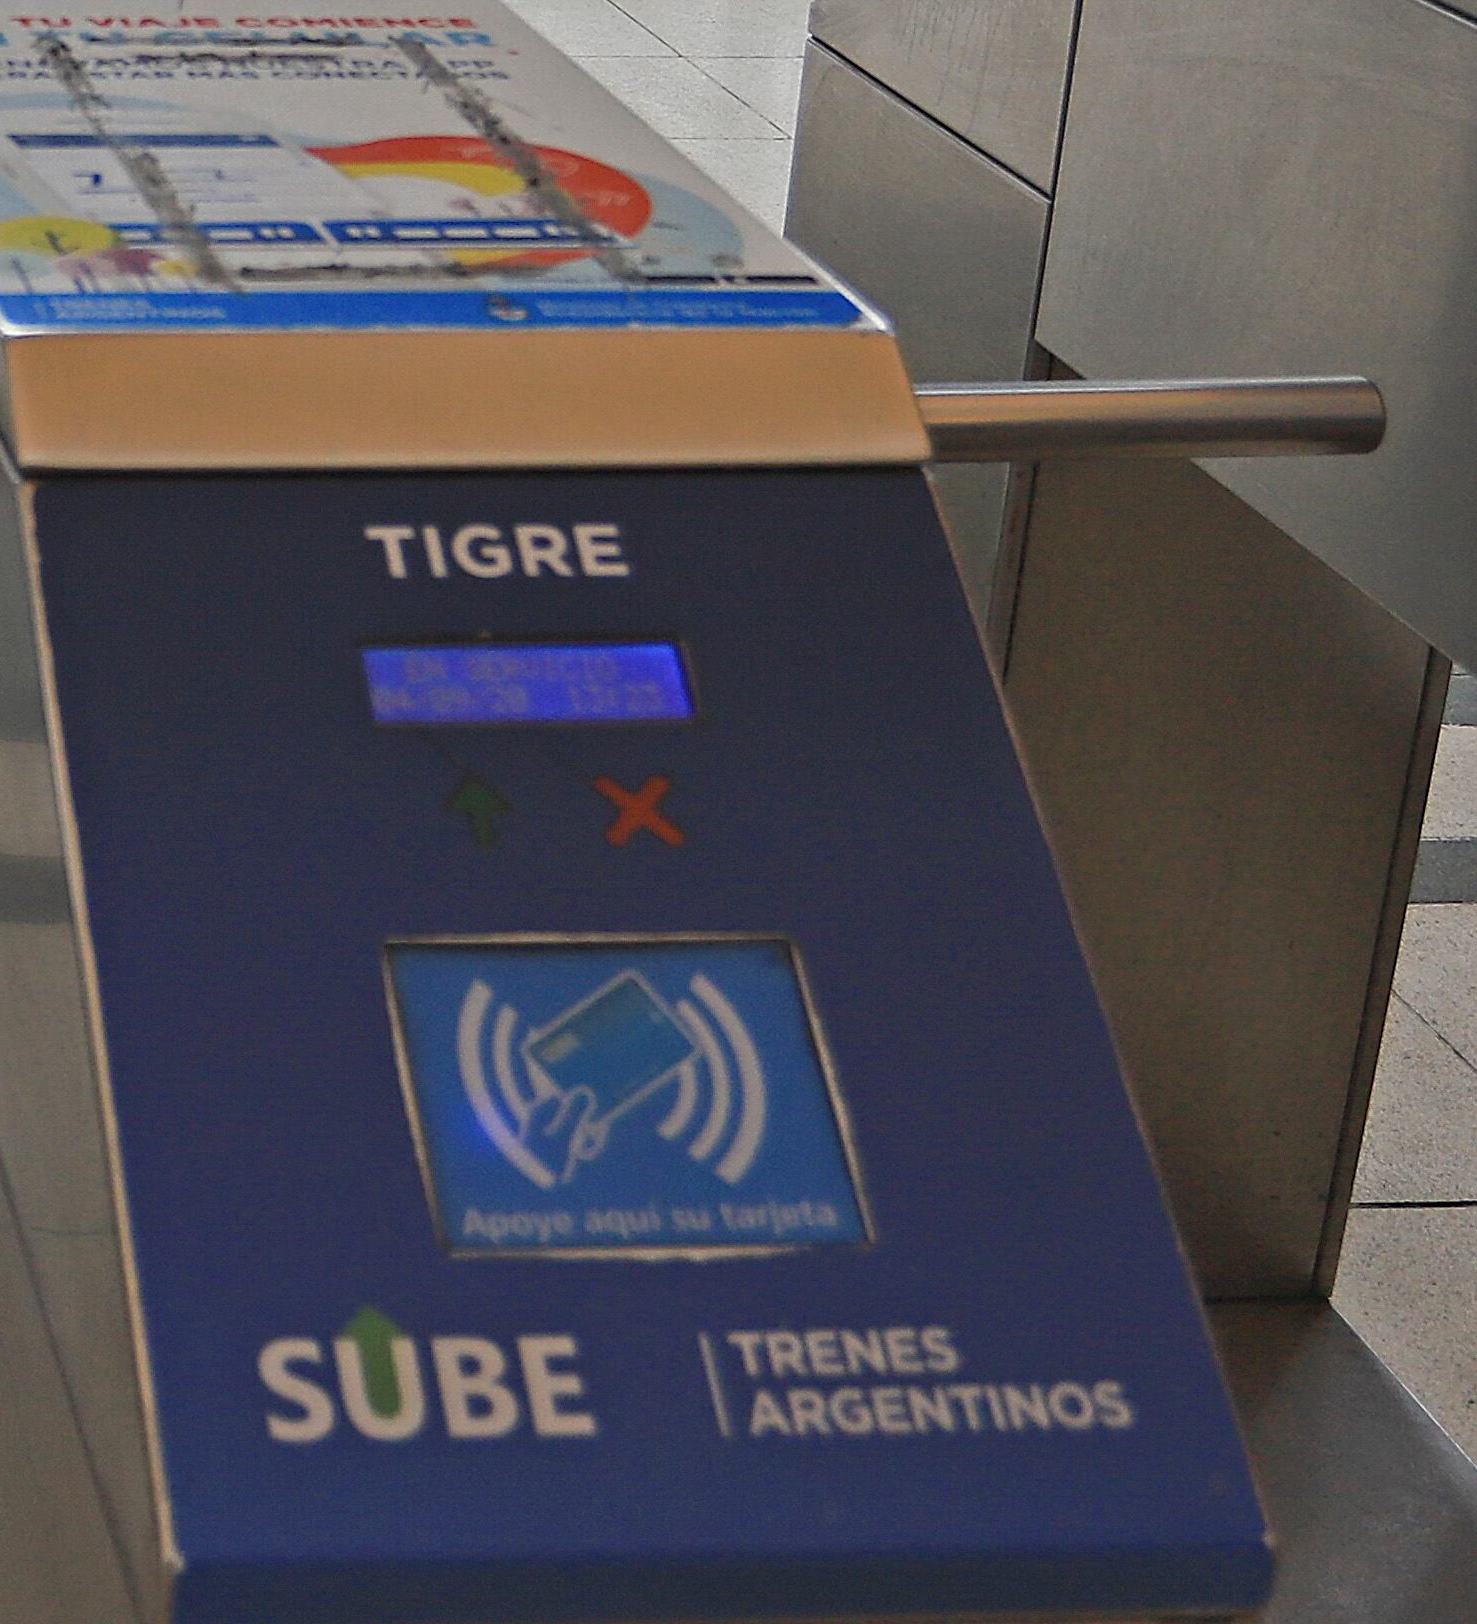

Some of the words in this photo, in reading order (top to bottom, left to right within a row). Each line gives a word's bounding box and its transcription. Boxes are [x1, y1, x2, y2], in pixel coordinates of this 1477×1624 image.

[13, 18, 72, 28] TU
[88, 18, 222, 28] VIAJE
[236, 18, 477, 28] COMIENCE
[363, 522, 631, 578] TIGRE
[462, 1207, 574, 1245] Apoye
[672, 1207, 711, 1232] su
[718, 1200, 839, 1236] tarjeta
[728, 1326, 960, 1375] TRENES
[256, 1333, 598, 1442] SUBE
[748, 1380, 1134, 1436] ARGENTINOS
